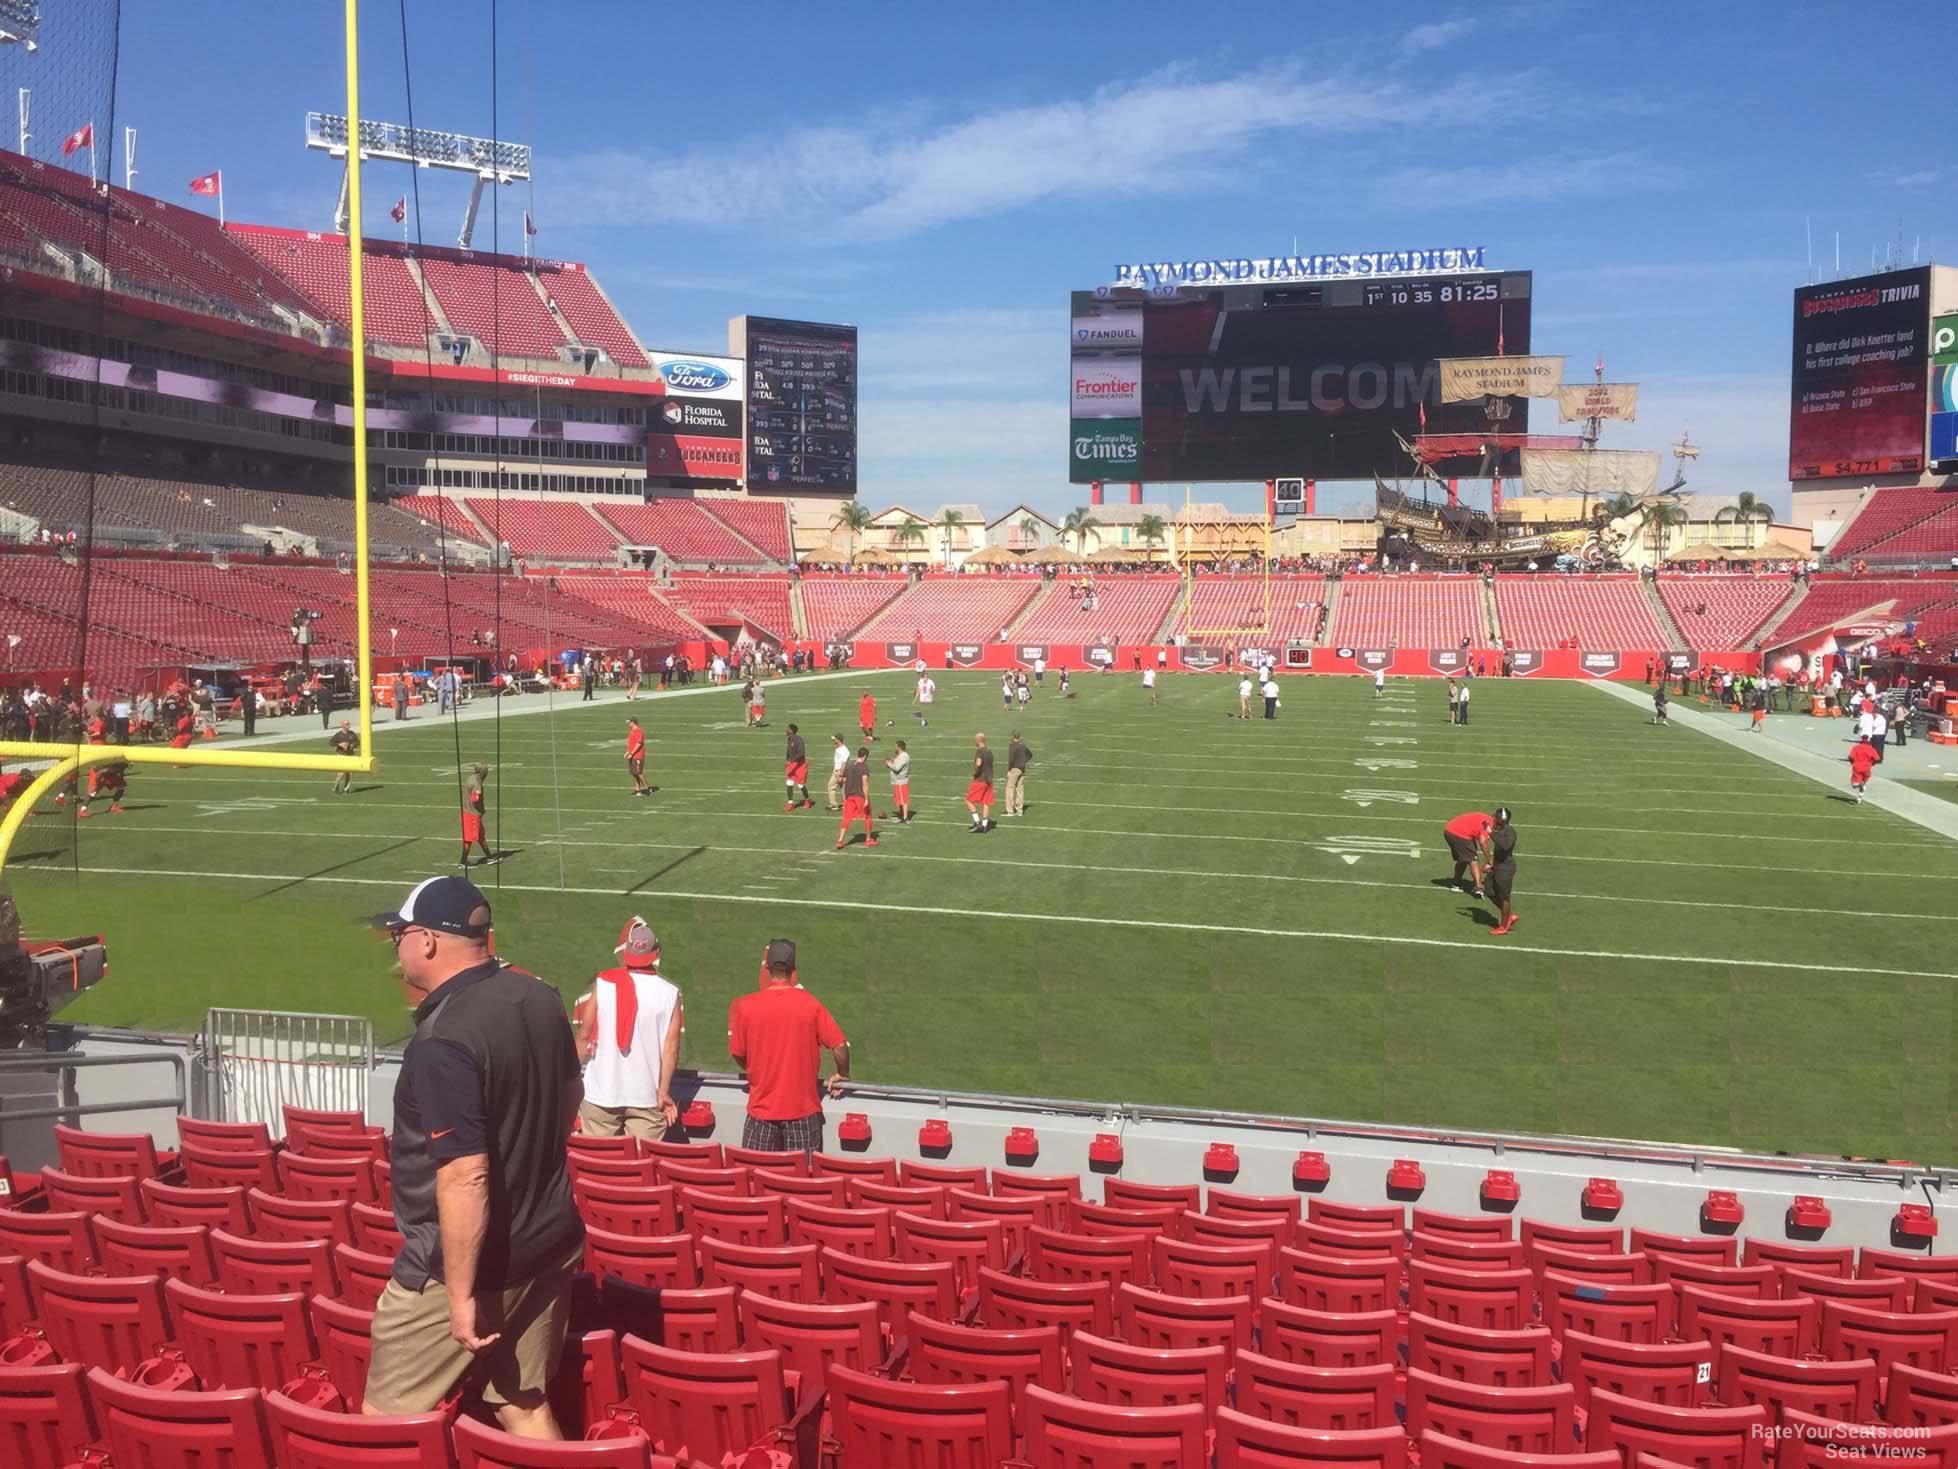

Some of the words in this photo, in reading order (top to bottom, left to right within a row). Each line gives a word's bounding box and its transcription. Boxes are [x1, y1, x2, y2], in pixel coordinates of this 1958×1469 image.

[1115, 258, 1253, 285] RAYMOND
[1259, 254, 1350, 279] JAMES
[1358, 247, 1486, 273] STADIUM
[1367, 293, 1384, 305] 1ST
[1391, 292, 1408, 304] 10
[1414, 291, 1433, 303] 35
[1440, 284, 1498, 302] 81:25
[1881, 284, 1920, 303] TRIVIA
[1090, 329, 1137, 340] FANDUEL
[1815, 341, 1838, 353] Where
[1896, 328, 1914, 341] land
[1806, 359, 1817, 369] his
[1818, 356, 1834, 368] first
[1834, 354, 1861, 366] college
[1862, 349, 1896, 363] coaching
[1896, 345, 1914, 361] job?
[668, 364, 716, 388] Ford
[1453, 367, 1512, 378] RAYMOND
[1512, 366, 1552, 377] JAMES
[1075, 378, 1138, 394] Frontier
[1179, 361, 1442, 413] WELCOM
[1476, 379, 1525, 389] STADIUM
[1900, 382, 1916, 392] State
[684, 404, 723, 417] FLORIDA
[684, 415, 728, 427] HOSPITAL
[681, 448, 742, 466] UCCANEERS
[1075, 437, 1138, 460] Times
[1279, 482, 1301, 498] 40
[1699, 1366, 1710, 1379] 21
